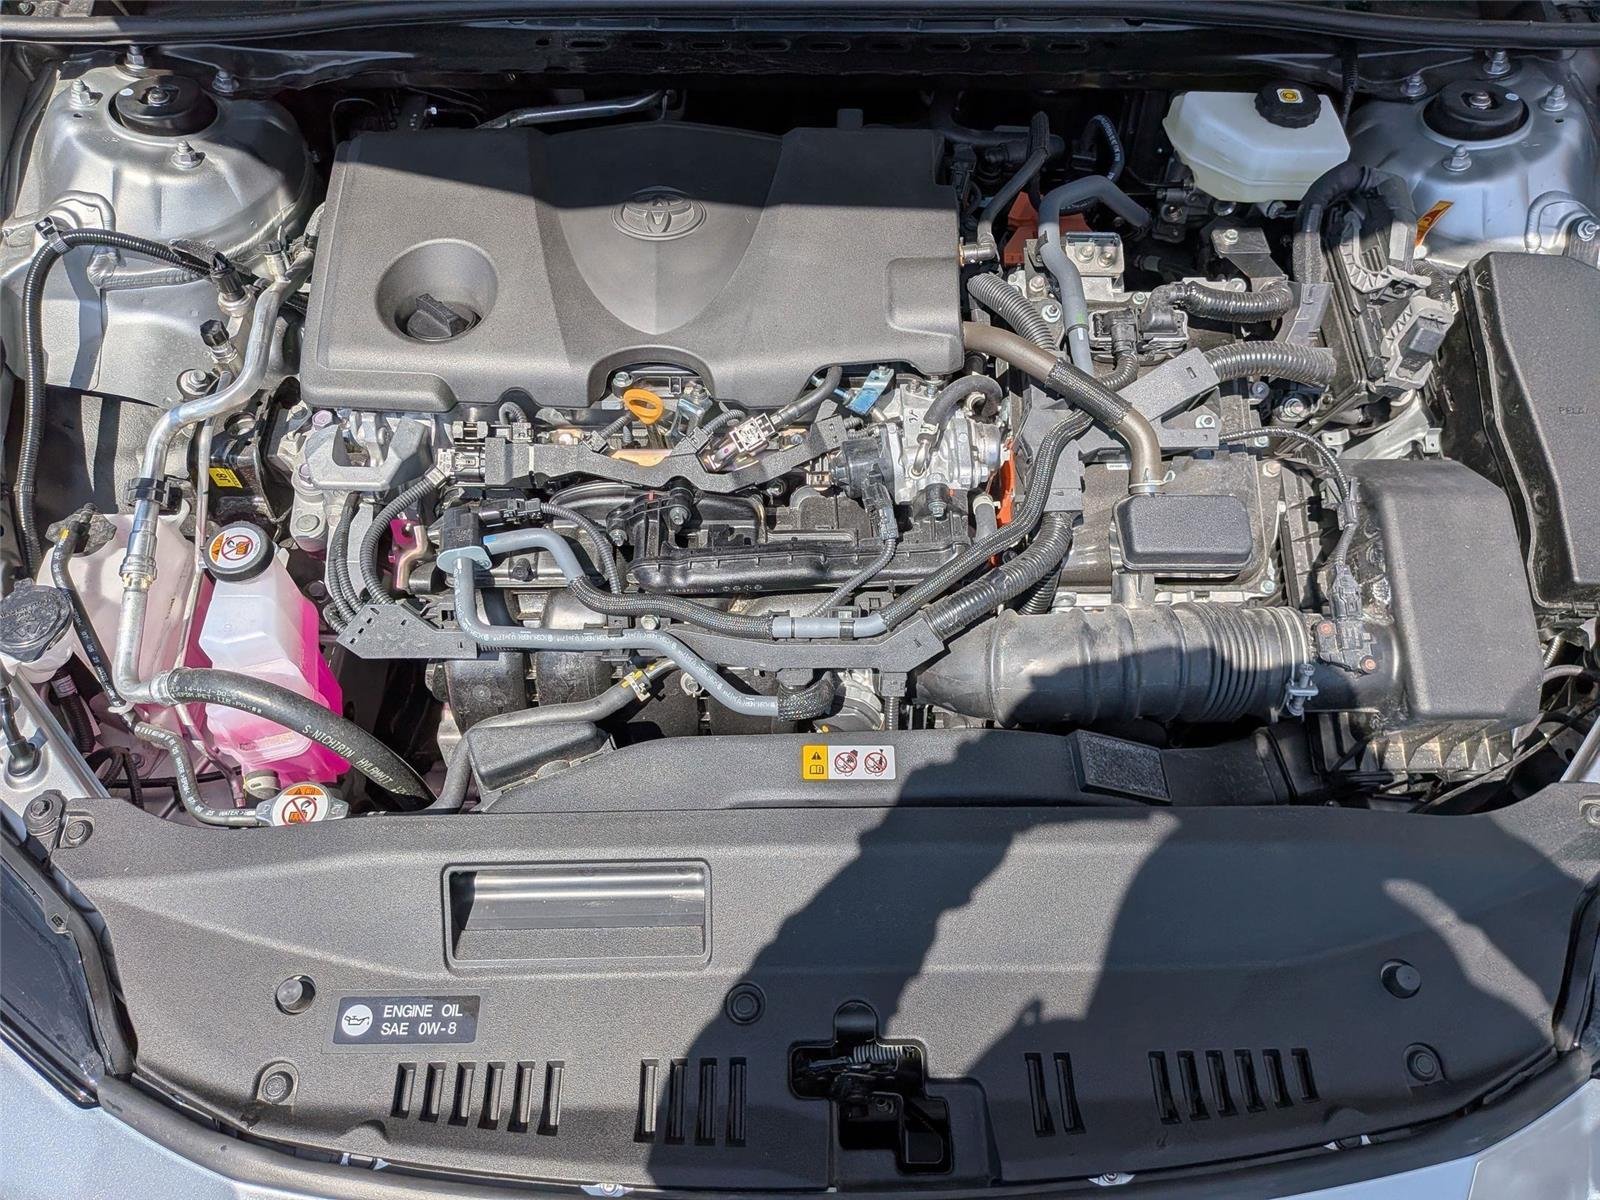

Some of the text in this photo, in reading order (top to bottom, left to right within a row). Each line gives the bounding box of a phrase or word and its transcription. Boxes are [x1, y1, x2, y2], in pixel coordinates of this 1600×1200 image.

[383, 1004, 463, 1018] ENGINE OIL
[380, 1021, 457, 1036] SAE 0W-8
